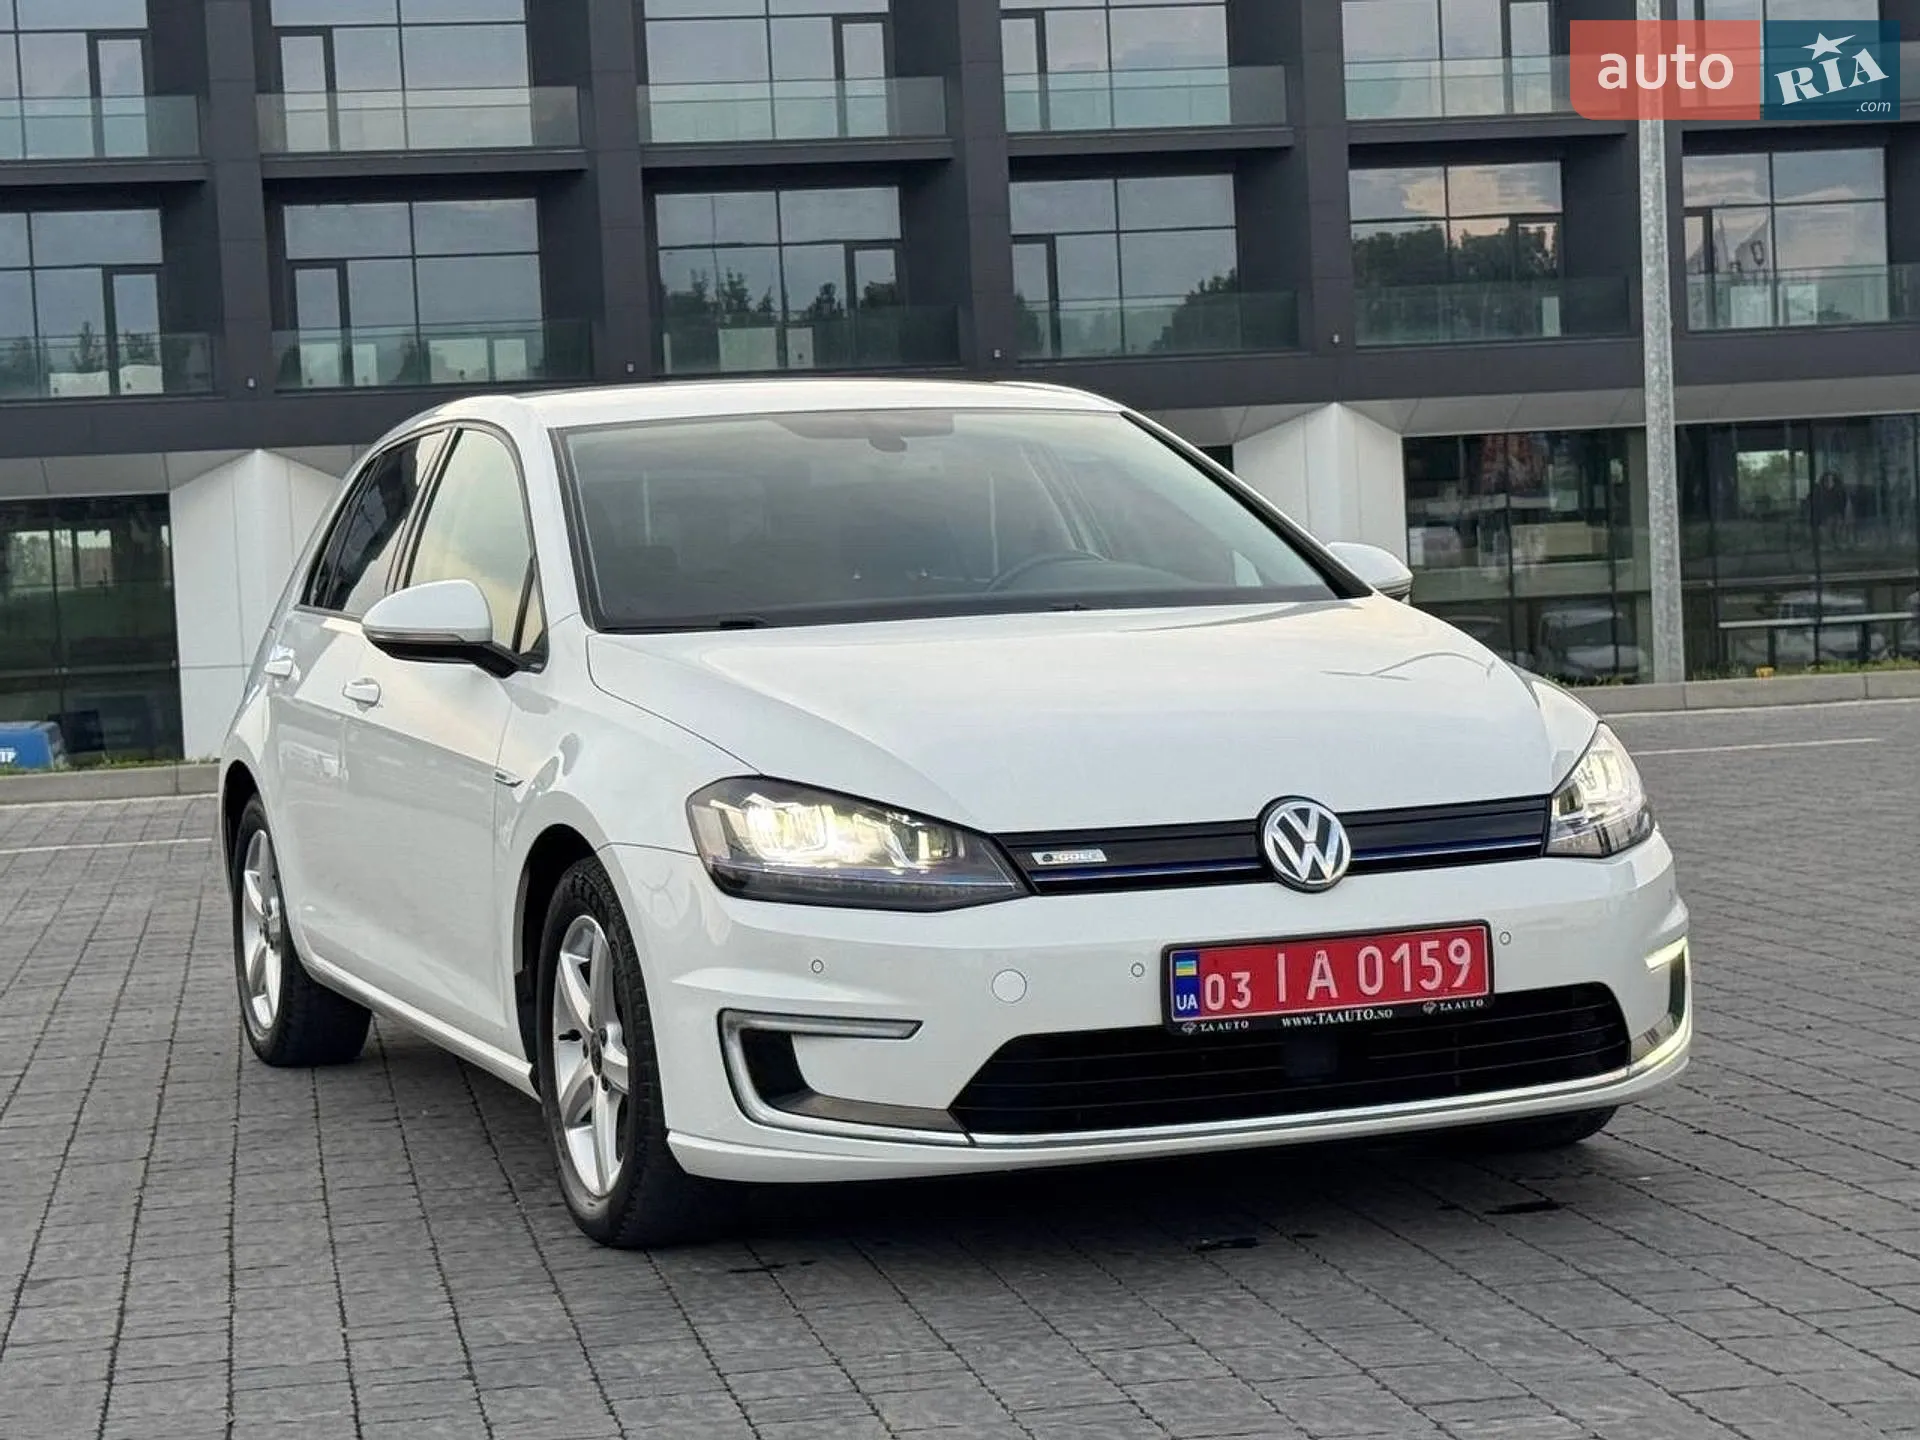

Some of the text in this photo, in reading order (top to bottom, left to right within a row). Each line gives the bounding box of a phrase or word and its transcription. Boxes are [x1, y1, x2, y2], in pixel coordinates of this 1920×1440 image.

[1266, 800, 1348, 884] VW
[1176, 993, 1198, 1011] UA
[1204, 938, 1472, 1011] 03 IA 0159
